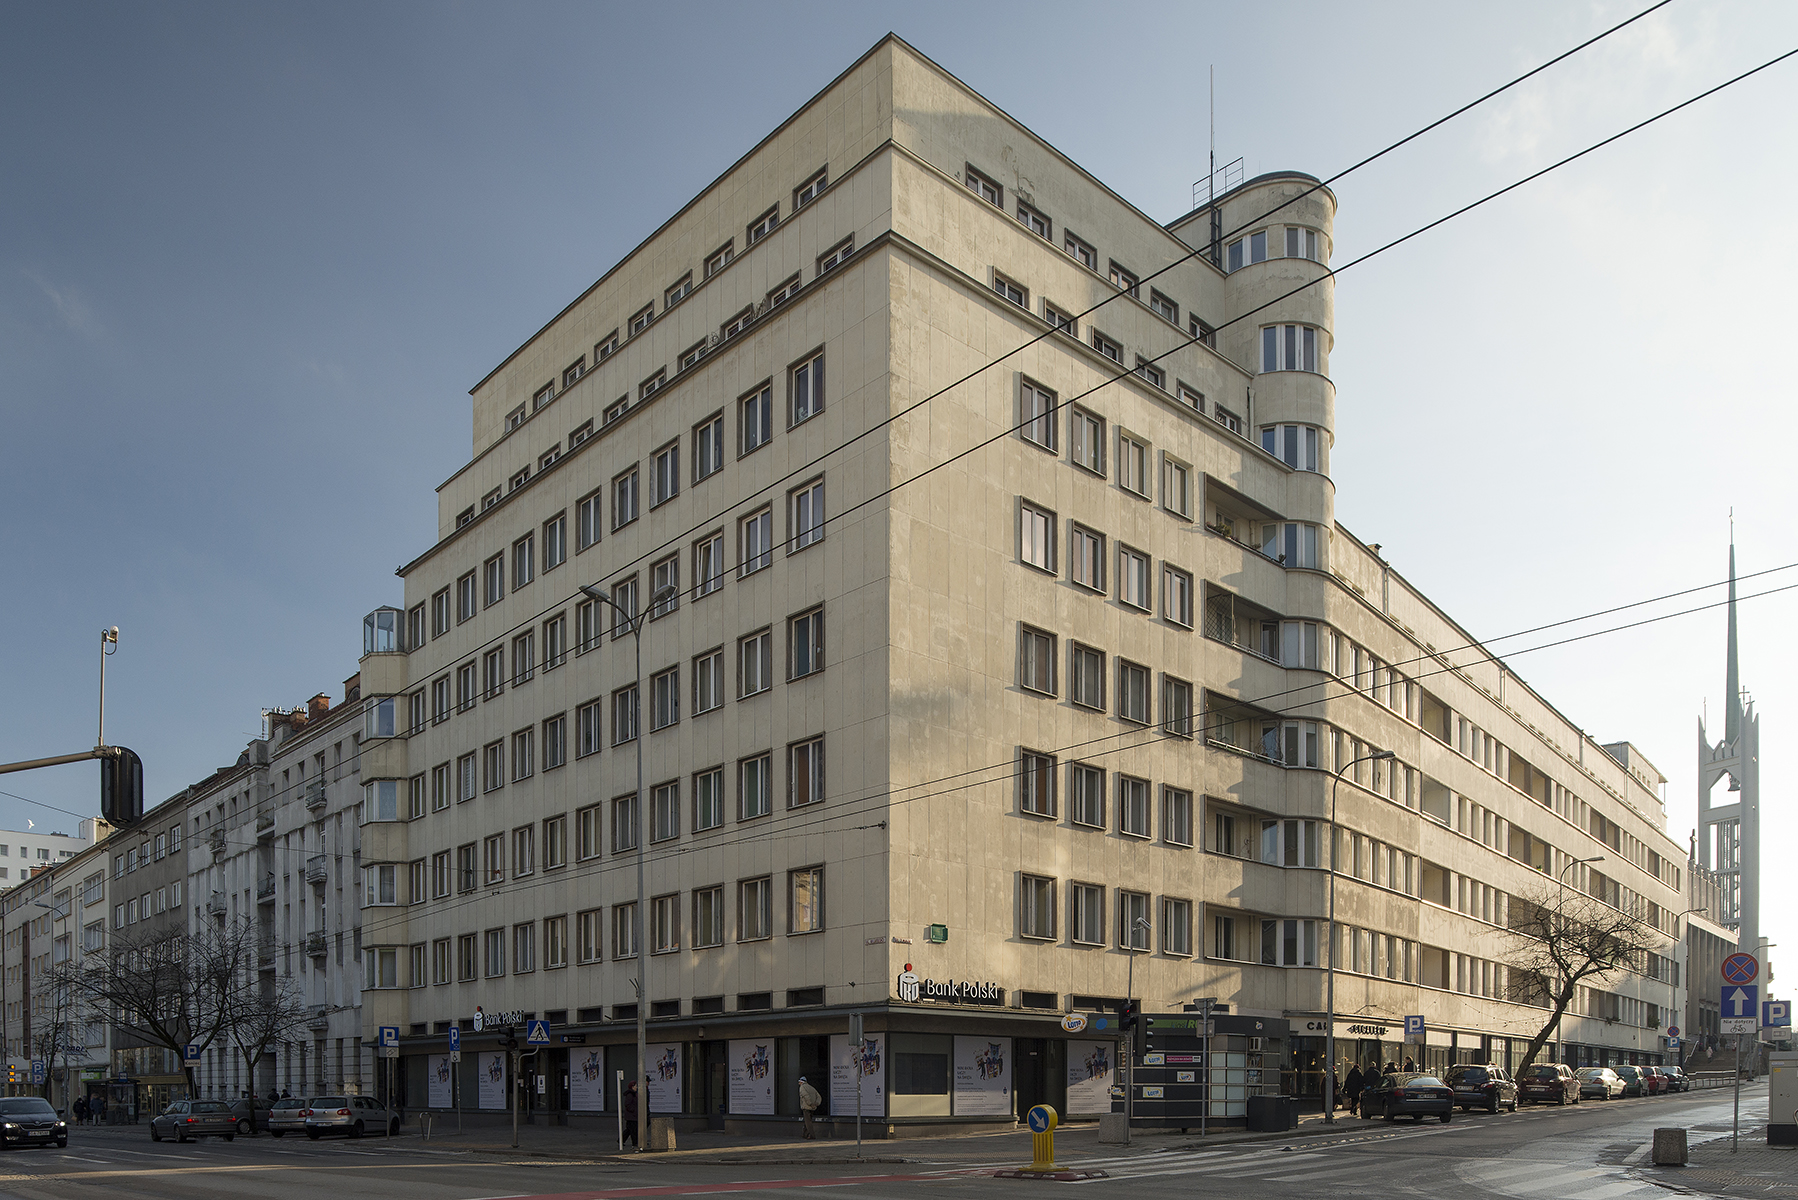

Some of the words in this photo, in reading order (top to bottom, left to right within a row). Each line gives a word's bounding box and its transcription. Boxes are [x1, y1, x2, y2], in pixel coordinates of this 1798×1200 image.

[926, 978, 959, 997] Bank
[962, 980, 998, 999] Polski
[486, 1012, 502, 1026] Bank
[503, 1010, 522, 1024] Polski
[1769, 1003, 1786, 1024] P
[1409, 1017, 1421, 1033] P
[383, 1028, 396, 1045] P
[451, 1029, 458, 1044] P
[1670, 1038, 1678, 1047] P
[187, 1046, 198, 1058] P
